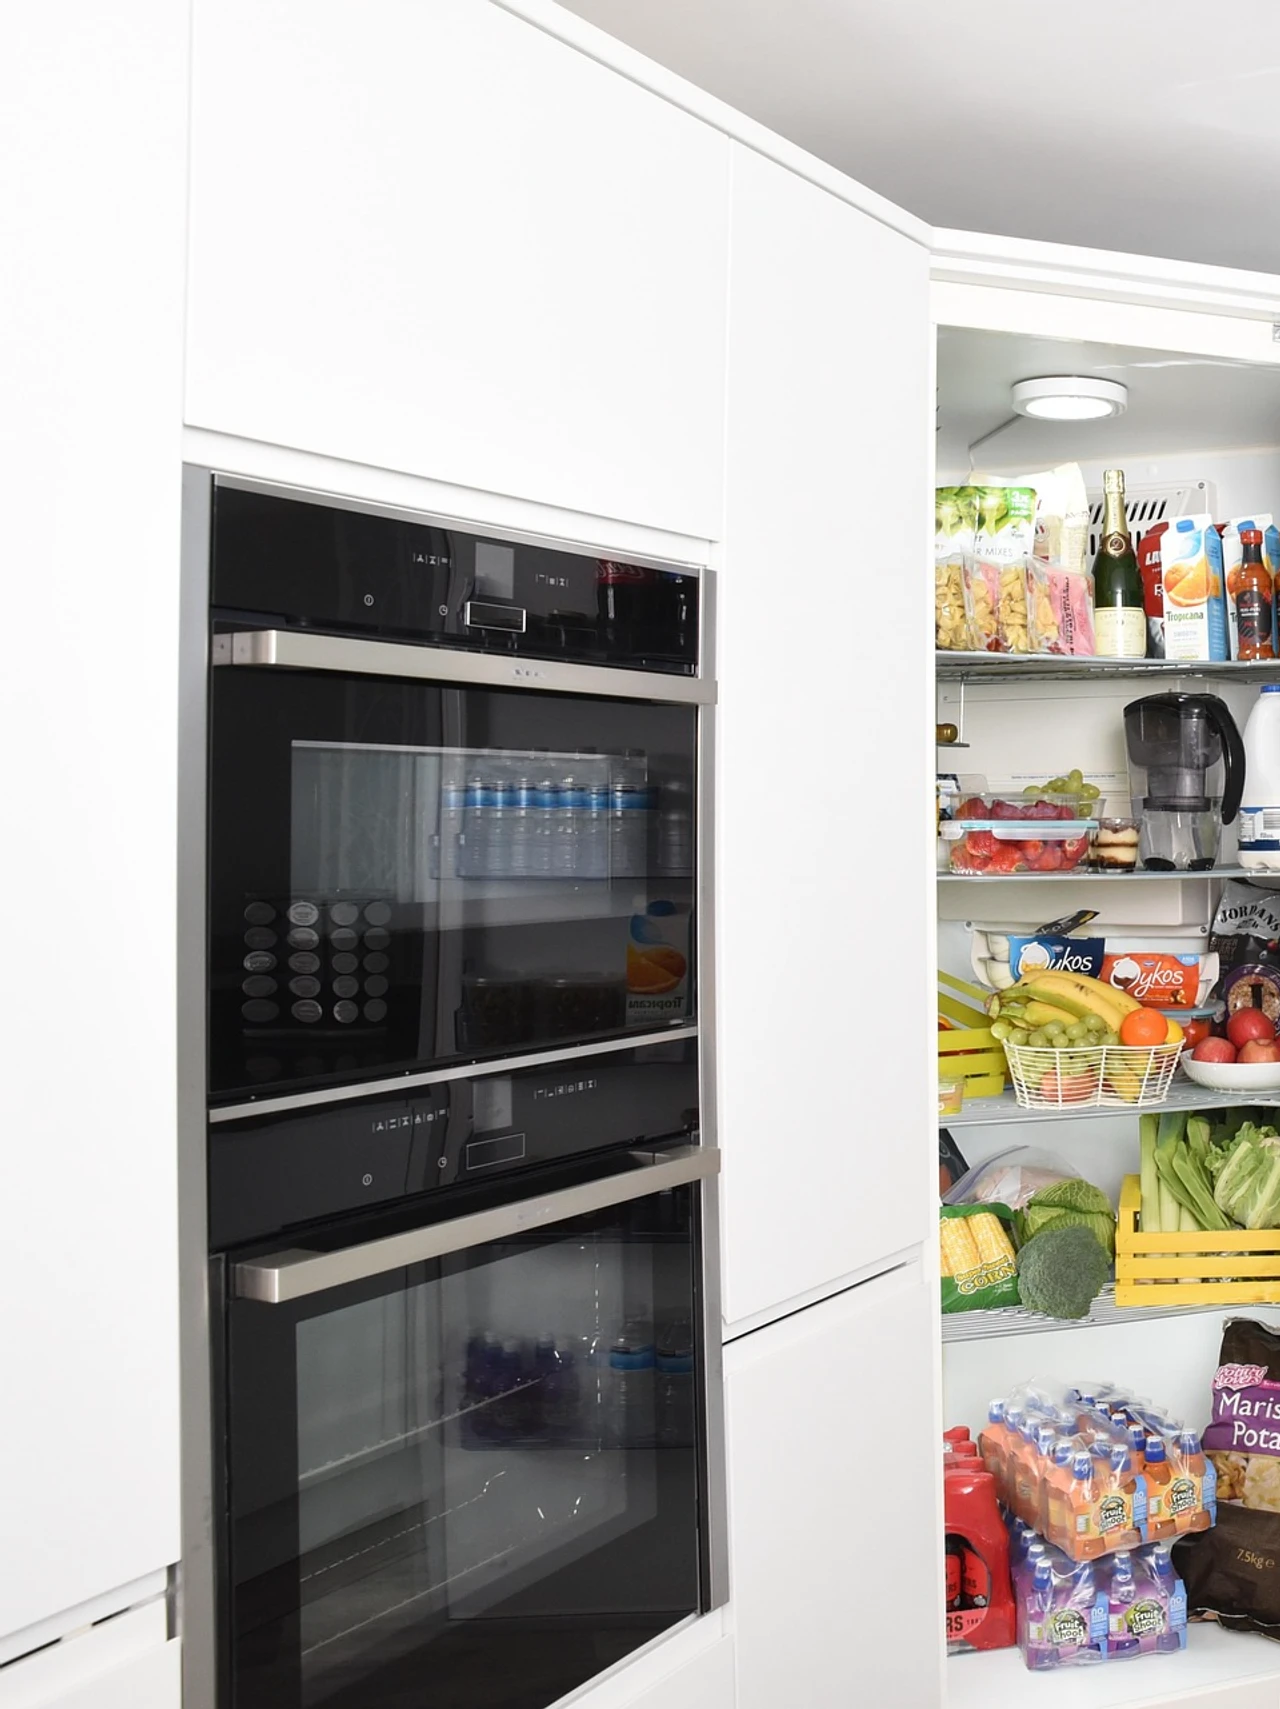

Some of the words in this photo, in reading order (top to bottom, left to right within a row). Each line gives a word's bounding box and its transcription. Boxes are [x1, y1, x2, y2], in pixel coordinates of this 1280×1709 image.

[985, 547, 1013, 557] MIXES
[1166, 611, 1203, 622] Tropicana
[1220, 905, 1280, 932] JORDANS
[1110, 956, 1184, 997] Oykos
[959, 1262, 1017, 1294] CORN
[1172, 1489, 1194, 1502] Fruit
[1171, 1498, 1197, 1513] Shoot
[1101, 1506, 1123, 1520] Fruit
[1237, 1548, 1264, 1569] 7.5kg
[1092, 1607, 1103, 1616] no
[1135, 1610, 1158, 1623] Fruit
[1055, 1619, 1080, 1632] Fruit
[1133, 1618, 1162, 1632] Shoot
